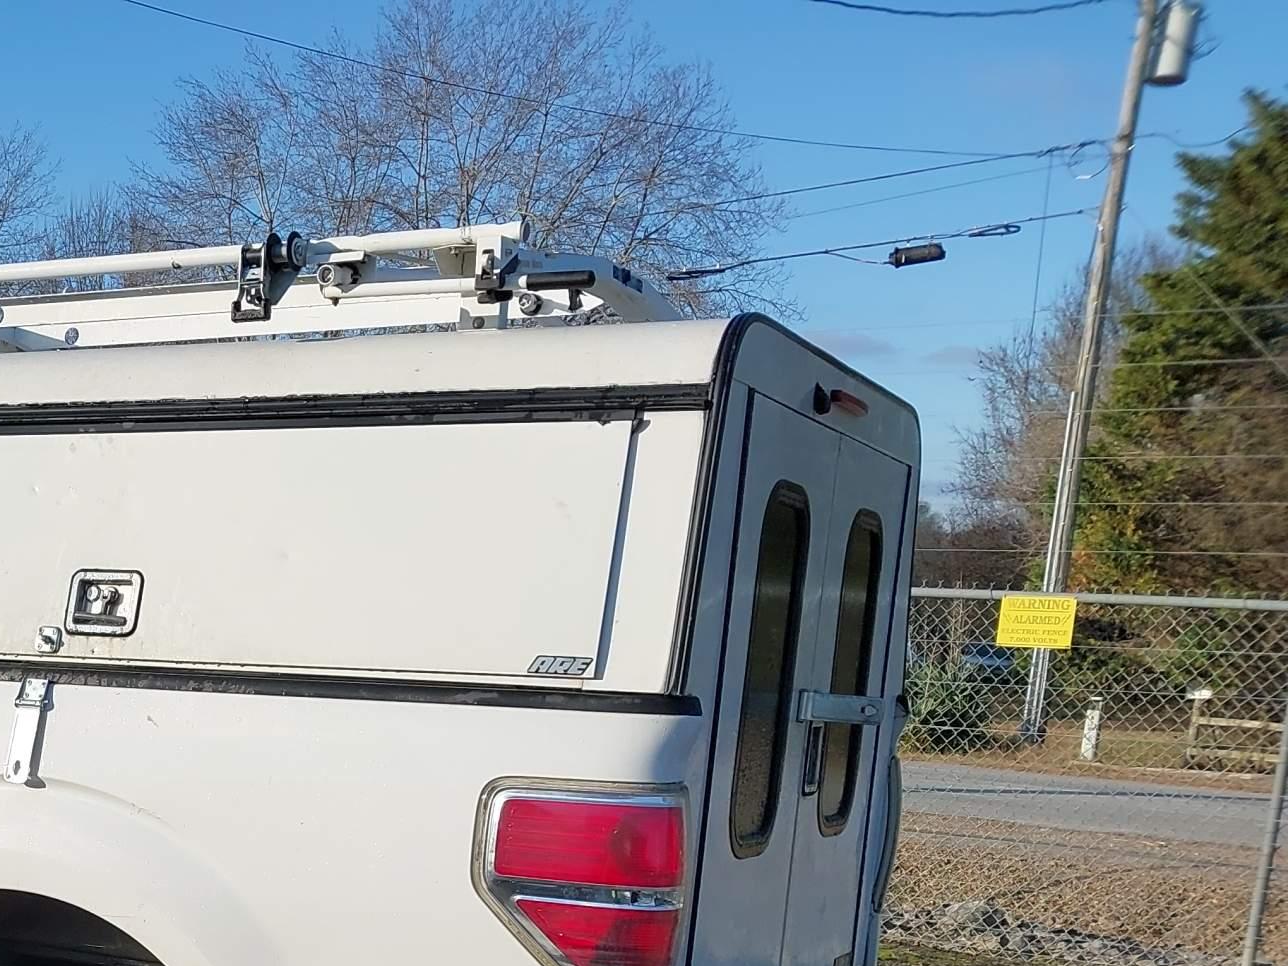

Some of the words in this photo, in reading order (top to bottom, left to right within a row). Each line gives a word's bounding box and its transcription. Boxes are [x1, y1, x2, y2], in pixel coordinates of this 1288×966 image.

[1007, 599, 1072, 610] WARNING
[1013, 615, 1061, 625] ALARMED
[528, 656, 592, 674] ARE
